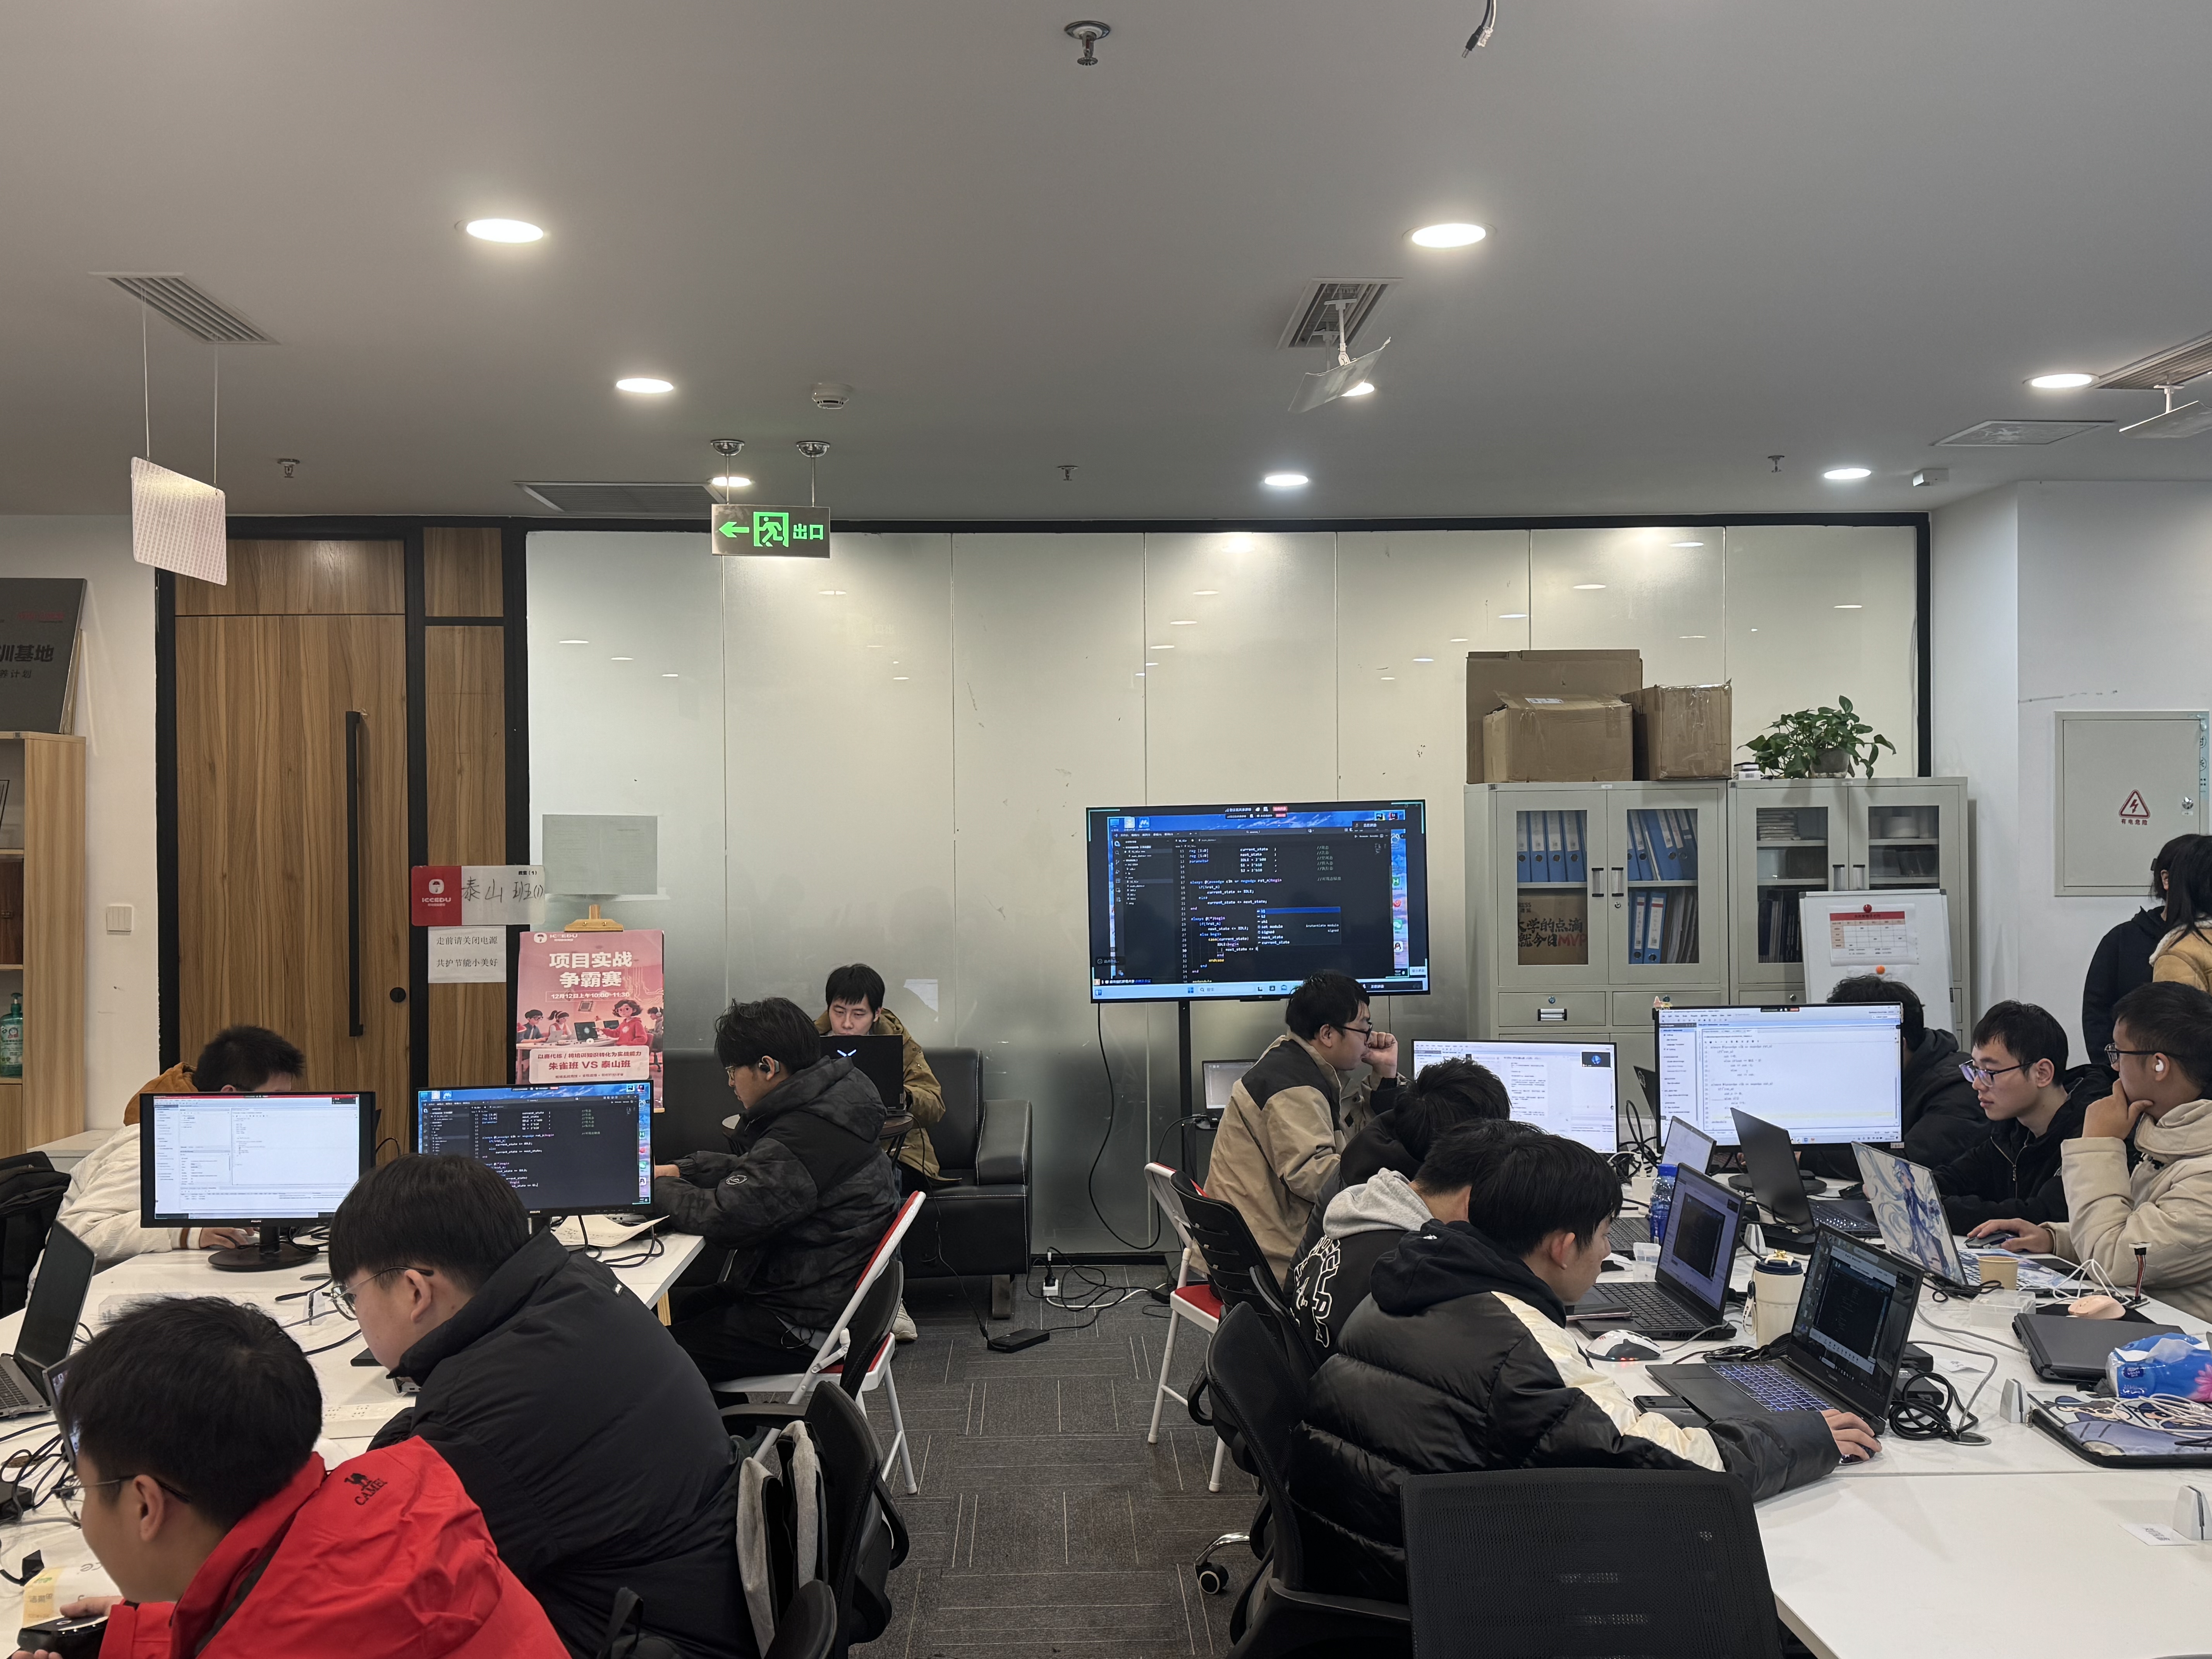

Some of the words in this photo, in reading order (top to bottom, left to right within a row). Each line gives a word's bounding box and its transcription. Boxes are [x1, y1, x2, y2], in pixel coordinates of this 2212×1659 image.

[793, 524, 824, 540] 出口
[436, 936, 498, 945] 走前请关闭电源
[436, 958, 498, 967] 共护节能小美好
[549, 951, 633, 969] 项目实战
[560, 971, 622, 988] 争霸赛
[548, 1061, 579, 1070] 朱雀班
[581, 1061, 598, 1069] VS
[601, 1060, 631, 1068] 泰山班
[355, 1478, 388, 1505] CAMEL
